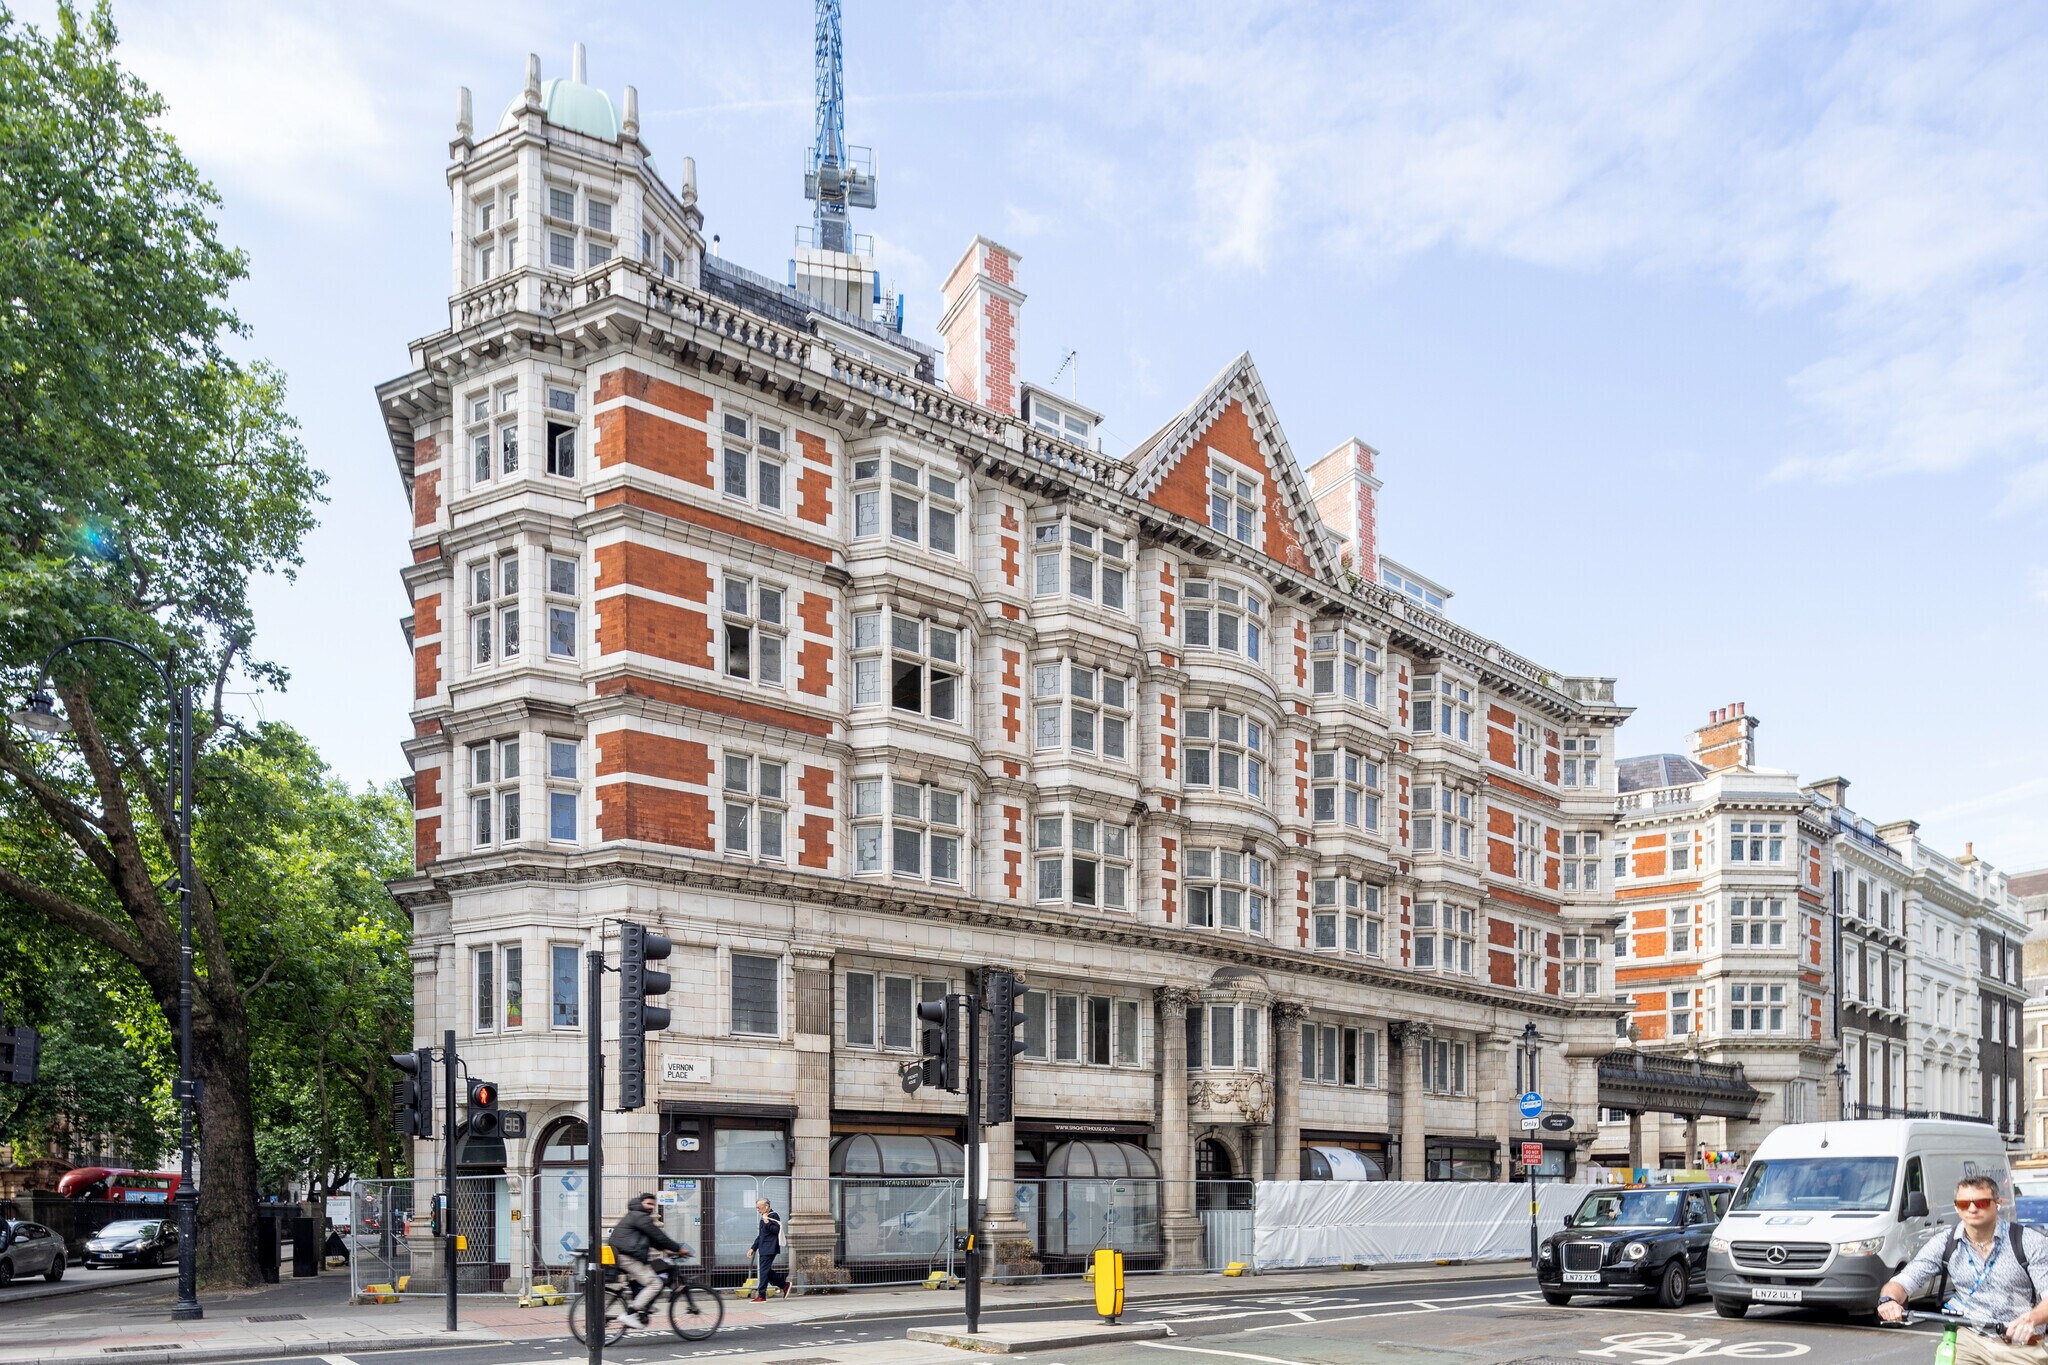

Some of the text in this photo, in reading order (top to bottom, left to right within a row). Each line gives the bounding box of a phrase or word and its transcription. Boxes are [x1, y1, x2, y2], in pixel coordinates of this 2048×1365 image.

[668, 1063, 694, 1071] VERNON
[668, 1071, 688, 1079] PLACE
[1637, 1095, 1700, 1109] SICILIAN AVENUE
[671, 1338, 859, 1359] LOOK LEFT
